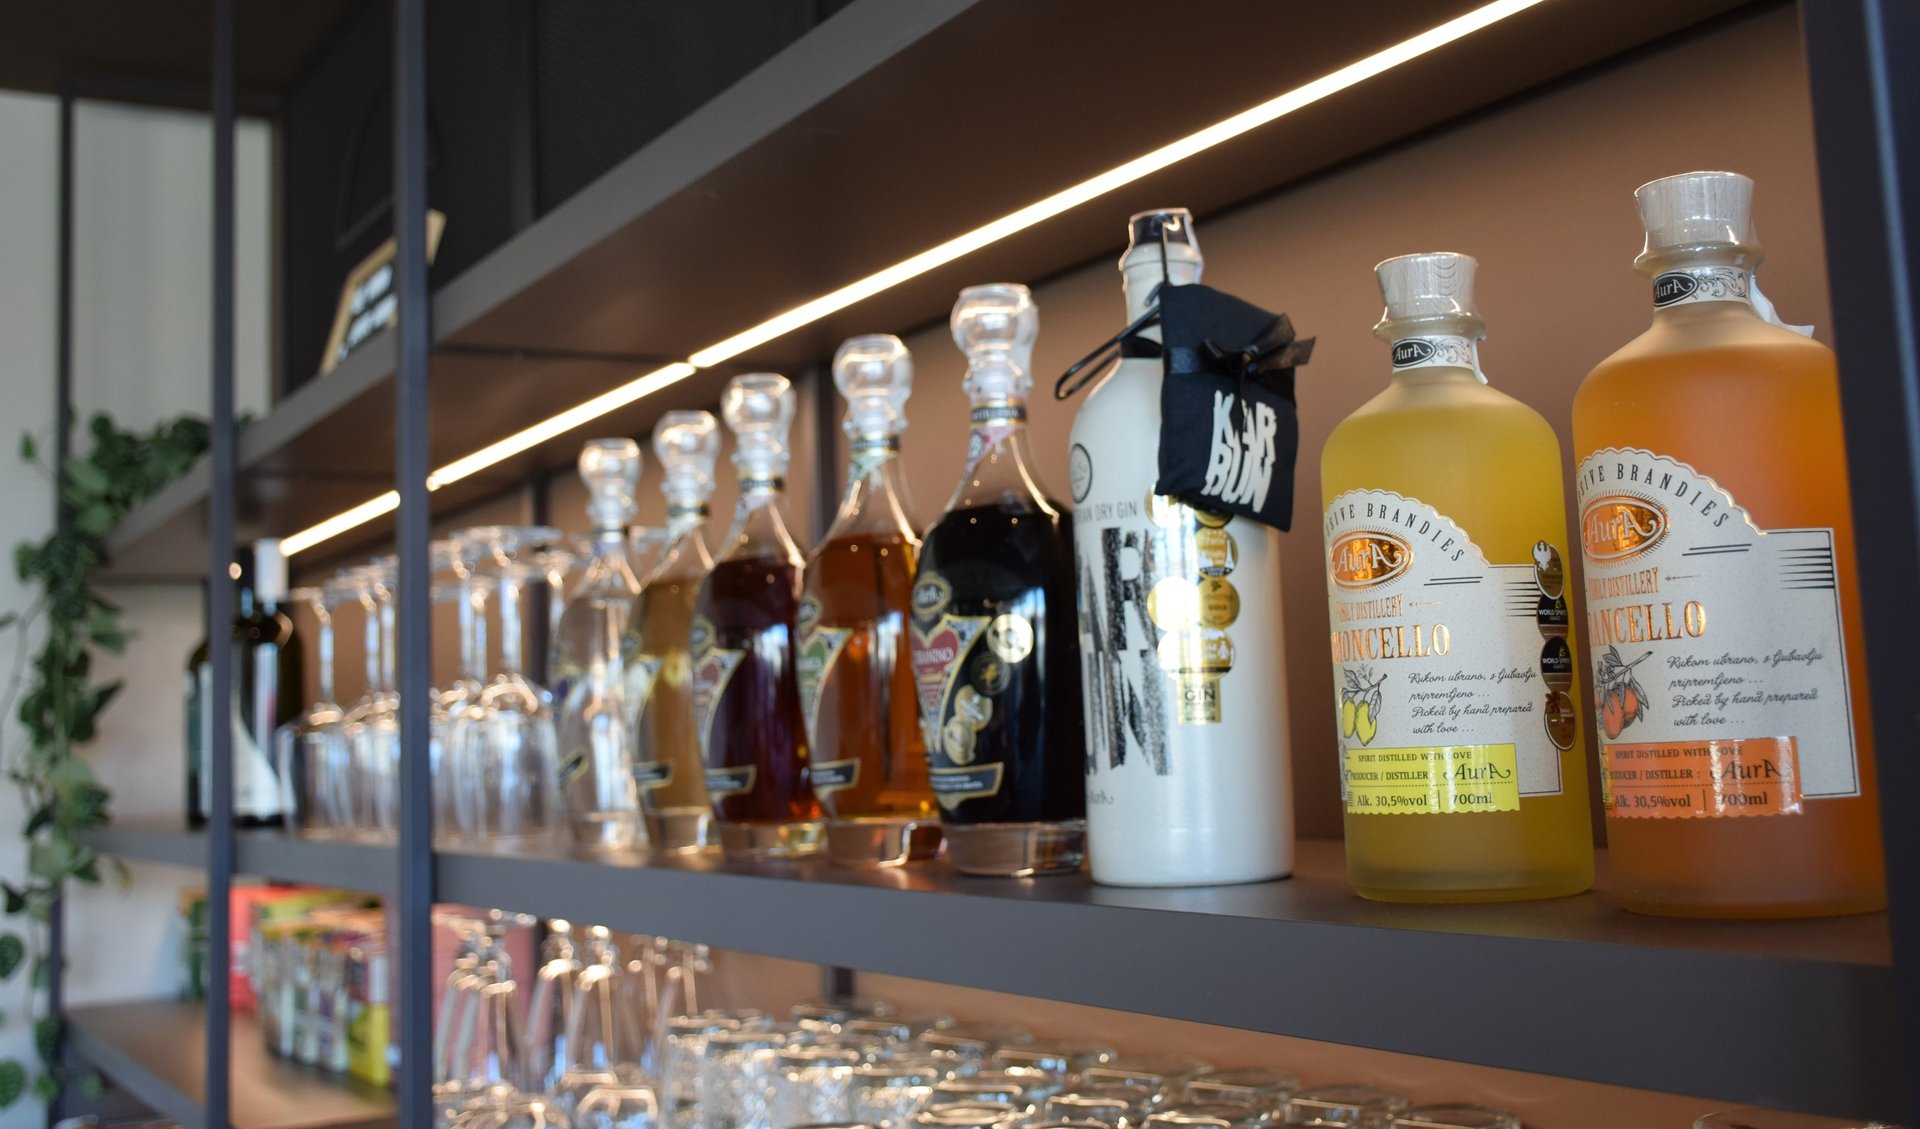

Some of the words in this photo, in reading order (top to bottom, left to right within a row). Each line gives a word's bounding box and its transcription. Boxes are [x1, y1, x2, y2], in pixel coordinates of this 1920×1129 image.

[1393, 344, 1431, 361] AurA
[1200, 442, 1273, 513] BUN
[1616, 463, 1729, 527] BRANDIES
[1117, 500, 1137, 519] GIN
[1367, 503, 1464, 561] BRANDIES
[1584, 508, 1657, 545] AurA
[1332, 543, 1403, 573] AurA
[1609, 567, 1659, 598] DISTILLERY
[1356, 594, 1404, 619] DISTILLERY
[1667, 655, 1710, 669] Rukom
[1713, 652, 1758, 665] ubrano,
[1762, 655, 1771, 664] s
[1772, 648, 1823, 668] ljubavlju
[1408, 671, 1445, 684] Rukom
[1448, 670, 1486, 681] ubrano,
[1489, 672, 1496, 681] s
[1497, 667, 1537, 684] ljubavlju
[1668, 672, 1744, 690] pripremljeno
[1185, 689, 1215, 702] GIN
[1409, 687, 1474, 703] pripremljeno
[1672, 694, 1712, 709] Picked
[1714, 692, 1729, 710] by
[1731, 691, 1763, 704] hand
[1763, 688, 1818, 705] prepared
[1412, 704, 1446, 718] Picked
[1448, 704, 1461, 720] by
[1463, 704, 1490, 715] hand
[1489, 702, 1533, 716] prepared
[1674, 713, 1698, 726] with
[1701, 712, 1726, 725] love
[1413, 722, 1435, 734] with
[1437, 722, 1458, 733] love
[1358, 754, 1376, 762] SPIRIT
[1379, 753, 1417, 762] DISTILLED
[1450, 751, 1472, 760] OVE
[1616, 750, 1633, 759] SPIRIT
[1636, 749, 1679, 759] DISTILLED
[1683, 748, 1709, 757] WITH
[1718, 746, 1743, 756] OVE
[1386, 771, 1428, 780] DISTILLER
[1443, 763, 1511, 780] AurA
[1646, 769, 1693, 780] DISTILLER
[1709, 759, 1782, 780] AurA
[1357, 796, 1372, 806] Alk.
[1375, 795, 1427, 808] 30,5%vol
[1453, 793, 1492, 805] 700ml
[1615, 795, 1631, 807] Alk.
[1634, 793, 1691, 808] 30,5%vol
[1720, 791, 1768, 805] 700ml
